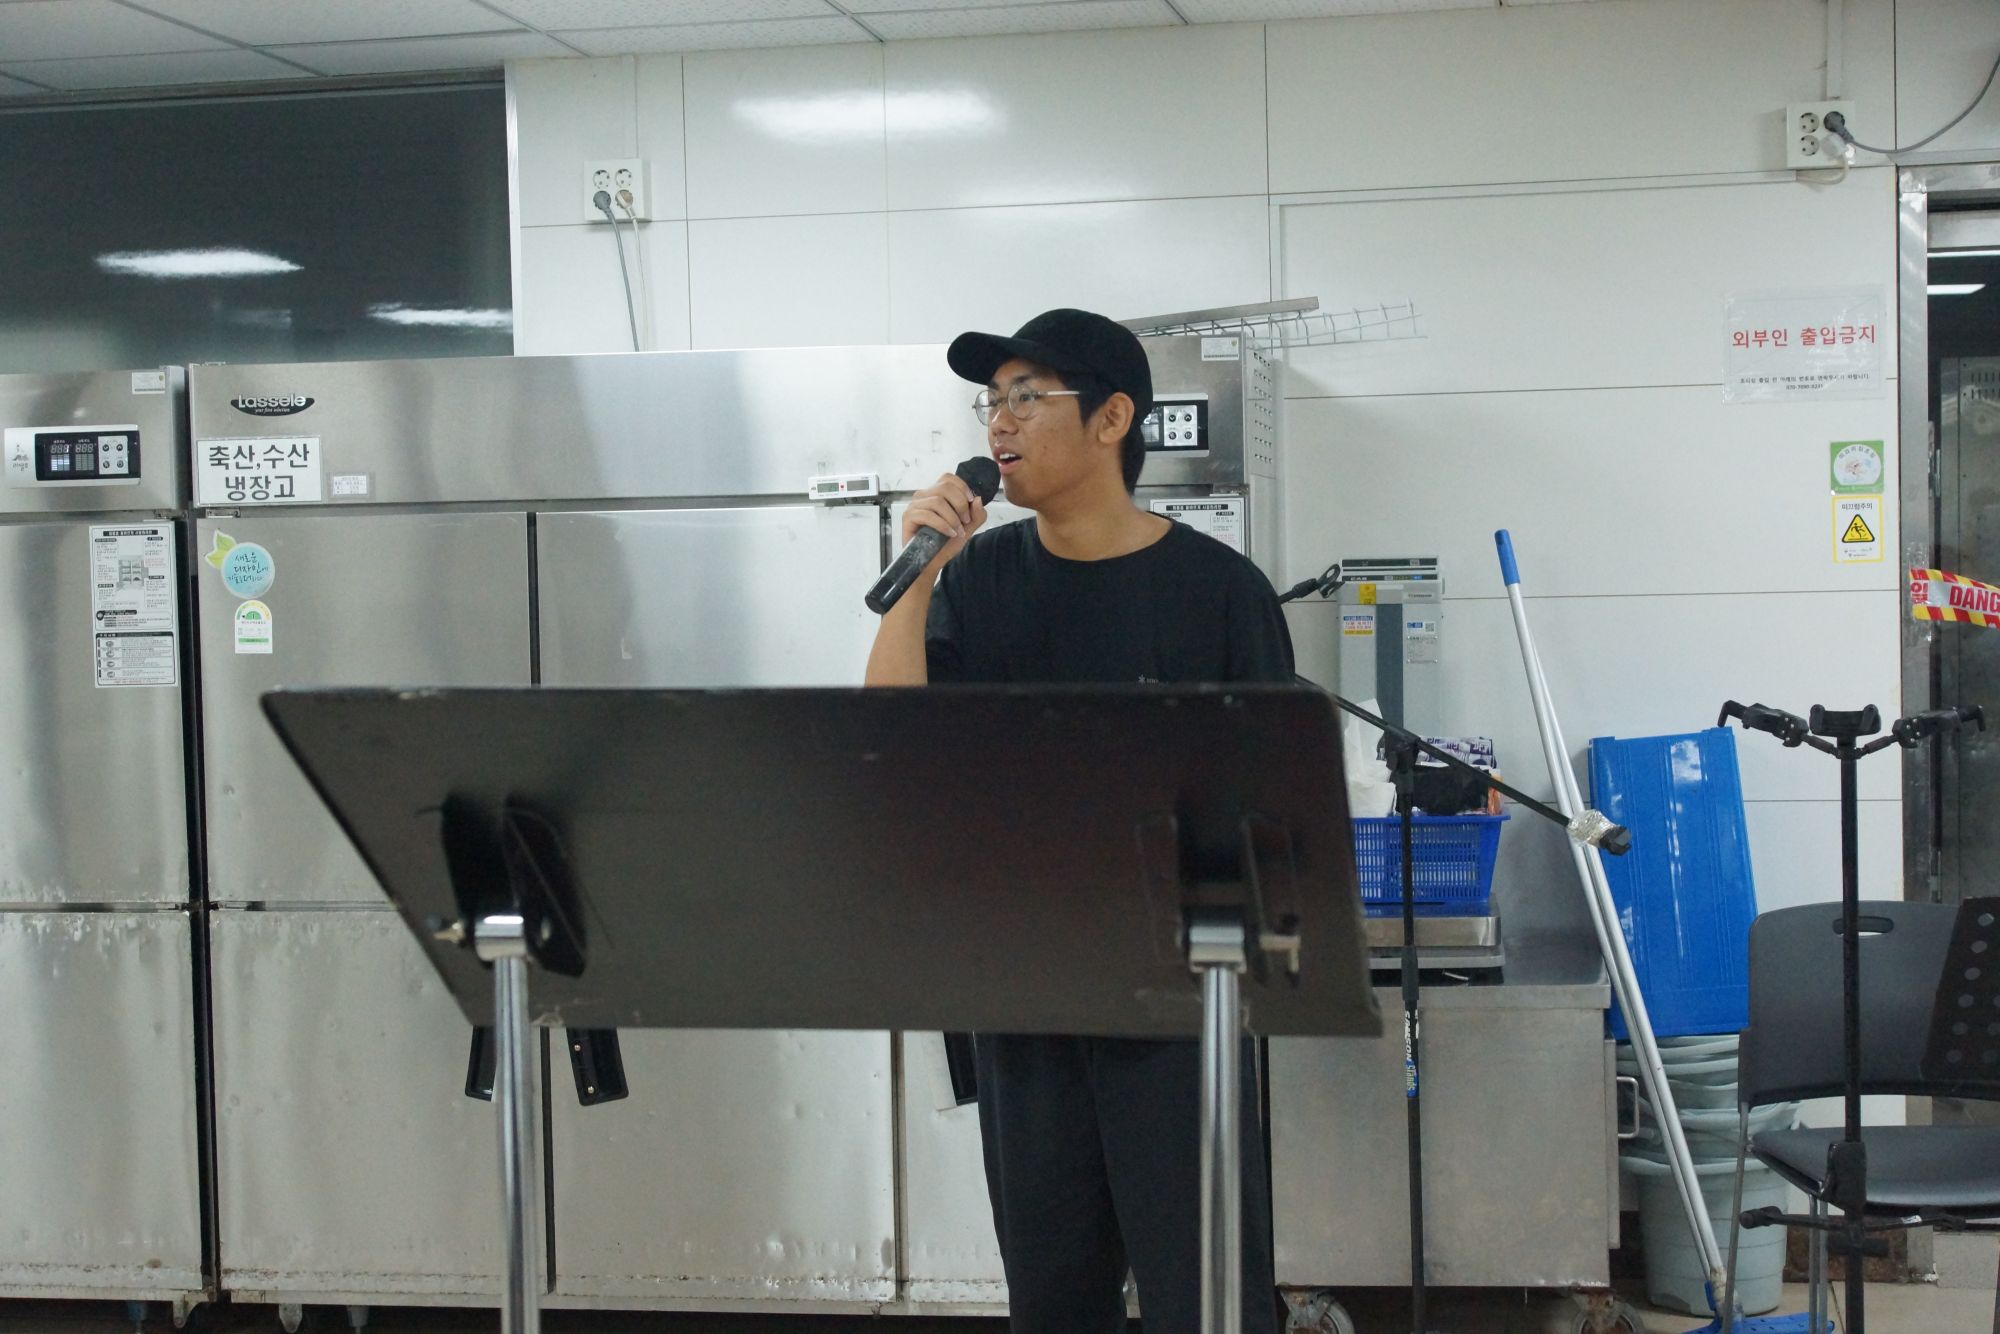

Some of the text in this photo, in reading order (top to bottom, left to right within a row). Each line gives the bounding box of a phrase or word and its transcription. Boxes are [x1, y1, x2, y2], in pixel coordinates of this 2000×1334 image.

[1732, 324, 1875, 348] 외부인 출입금지
[238, 393, 307, 409] Lassele
[208, 443, 310, 471] 축산,수산
[225, 474, 296, 501] 냉장고
[1841, 502, 1873, 511] 미끄럼주의
